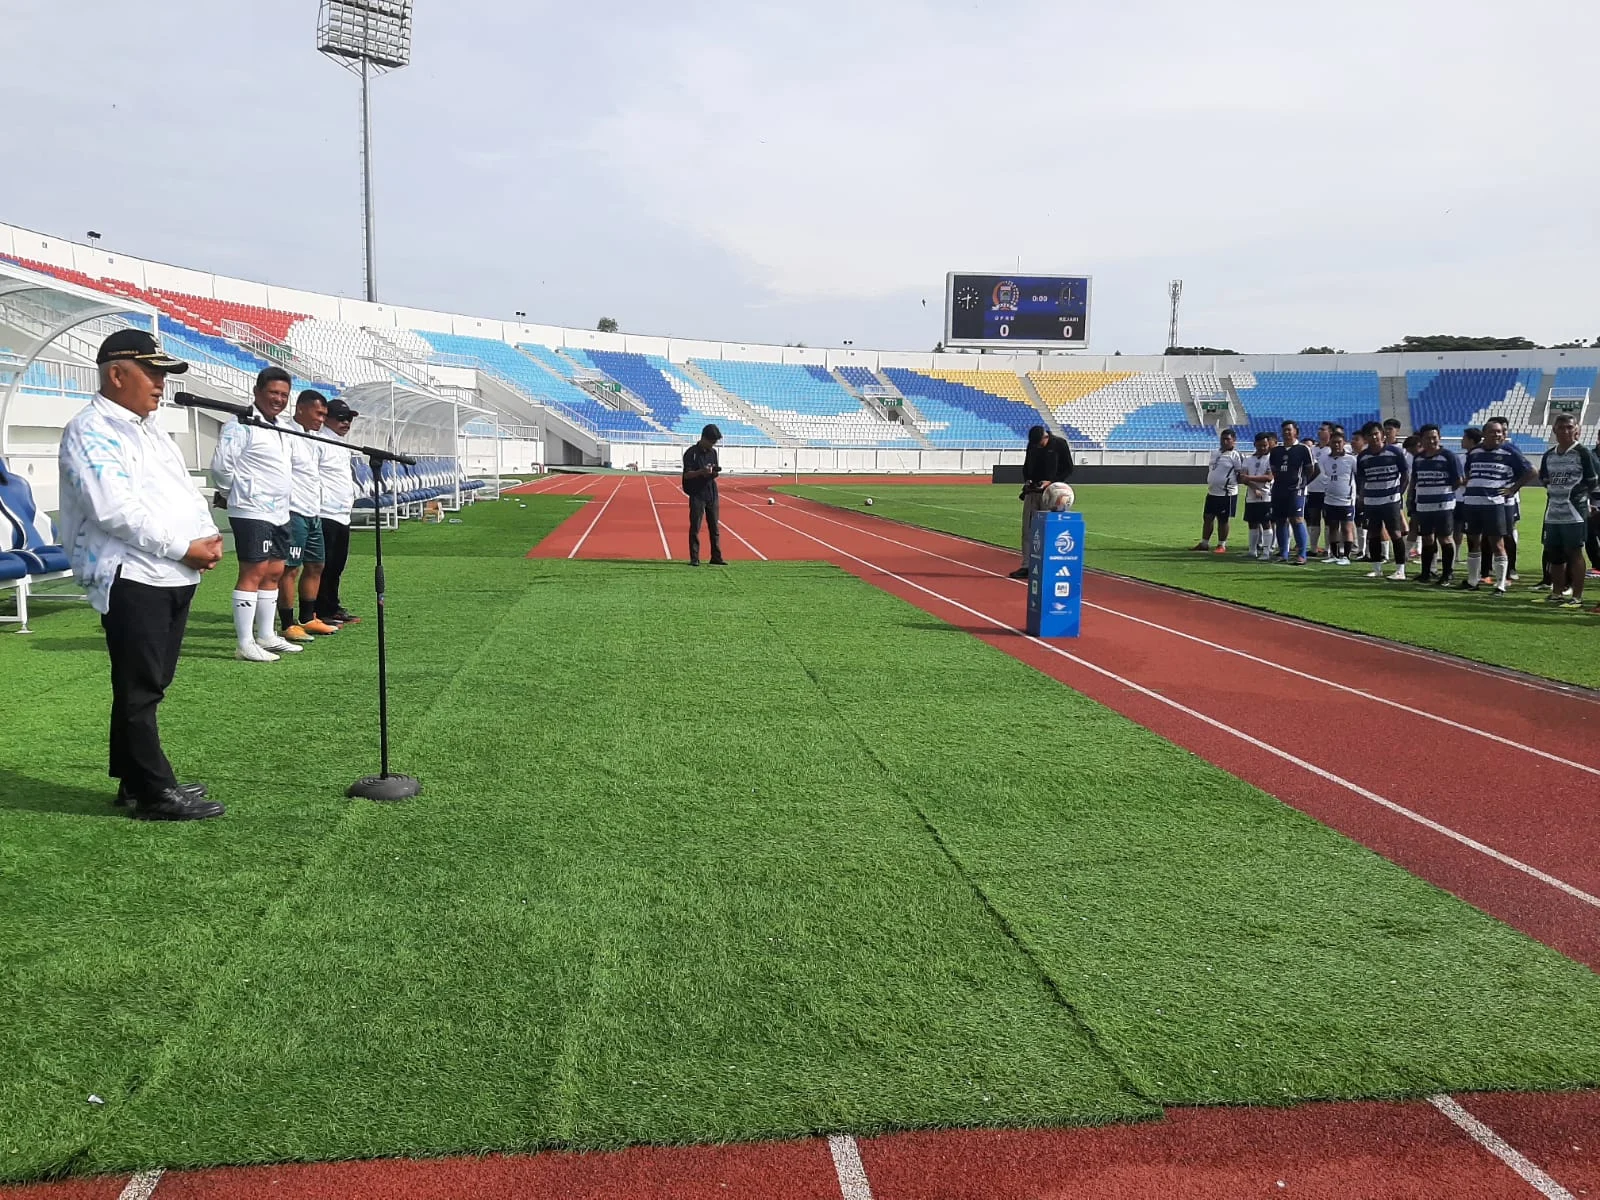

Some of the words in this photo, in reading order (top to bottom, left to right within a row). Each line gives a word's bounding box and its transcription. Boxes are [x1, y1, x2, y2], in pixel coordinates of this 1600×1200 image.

[999, 324, 1009, 337] 0
[1063, 325, 1073, 338] 0
[289, 546, 302, 559] 44
